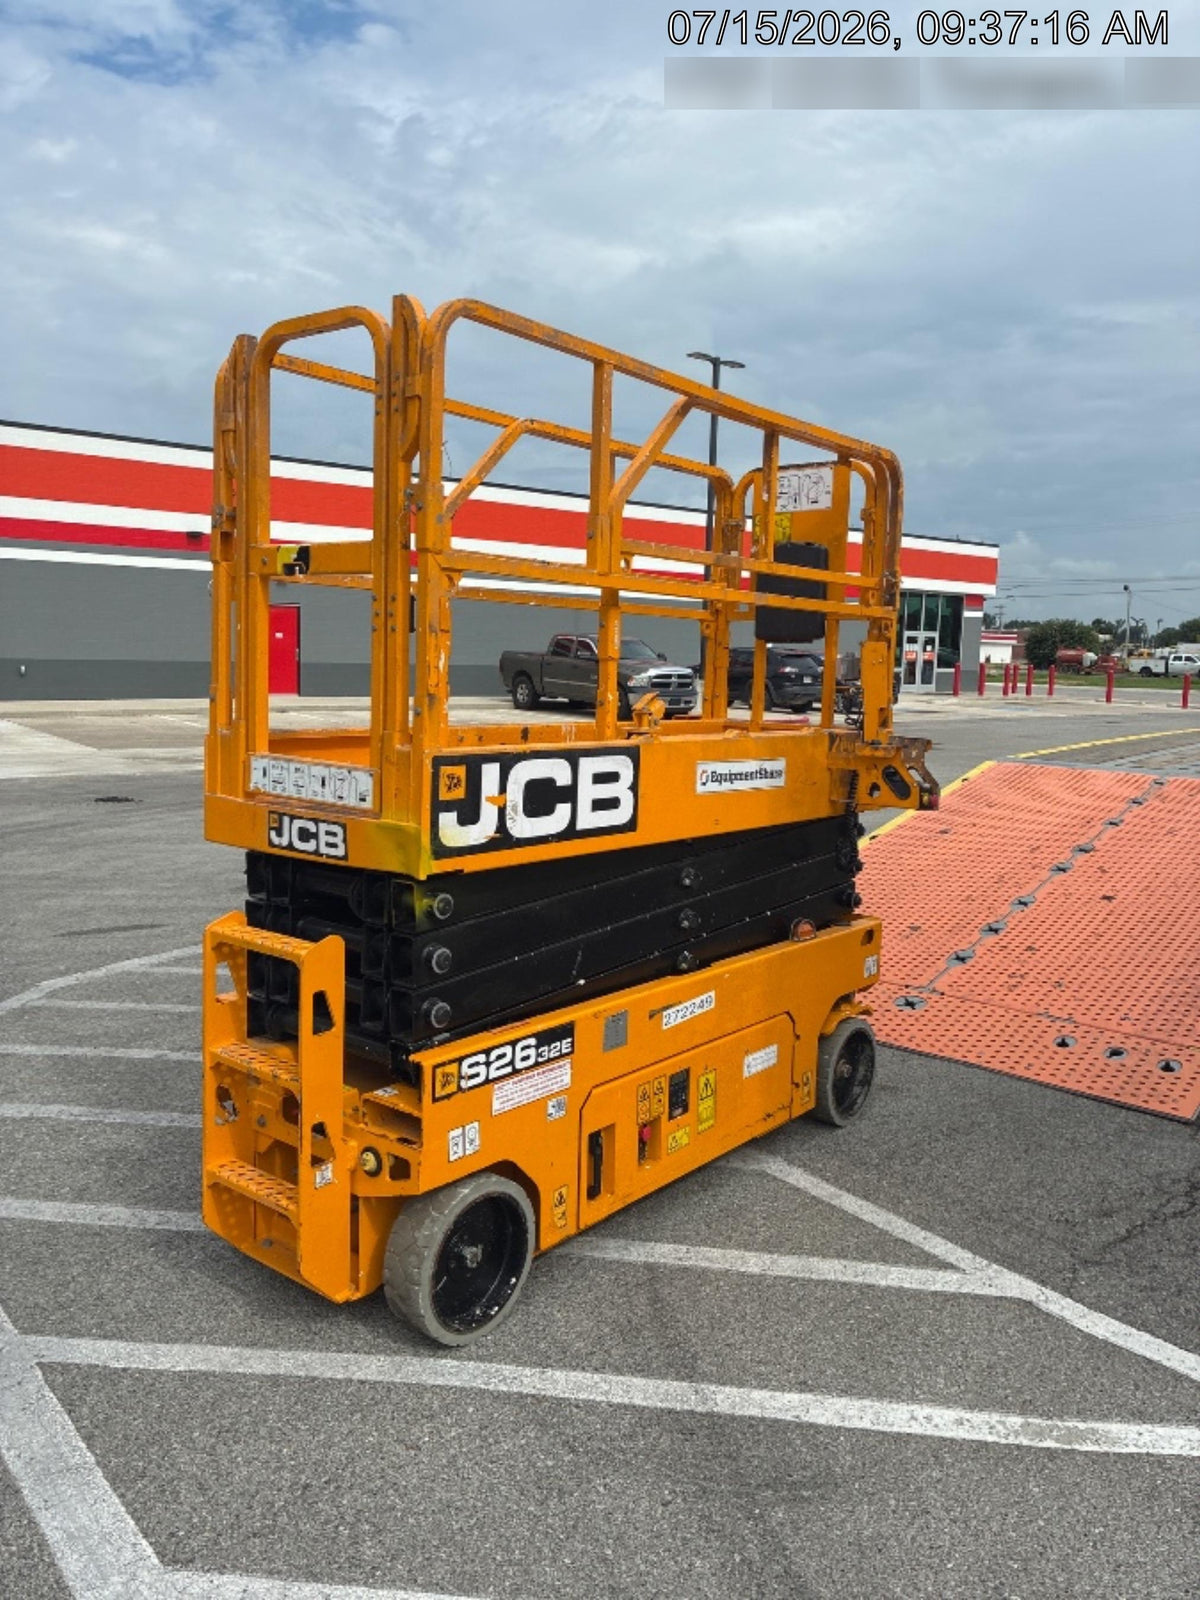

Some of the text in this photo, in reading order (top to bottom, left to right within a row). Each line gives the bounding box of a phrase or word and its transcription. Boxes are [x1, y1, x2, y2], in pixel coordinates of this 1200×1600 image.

[710, 767, 783, 786] EquipmentShare
[438, 755, 635, 848] JCB
[269, 815, 346, 857] JCB
[664, 995, 714, 1027] 272249
